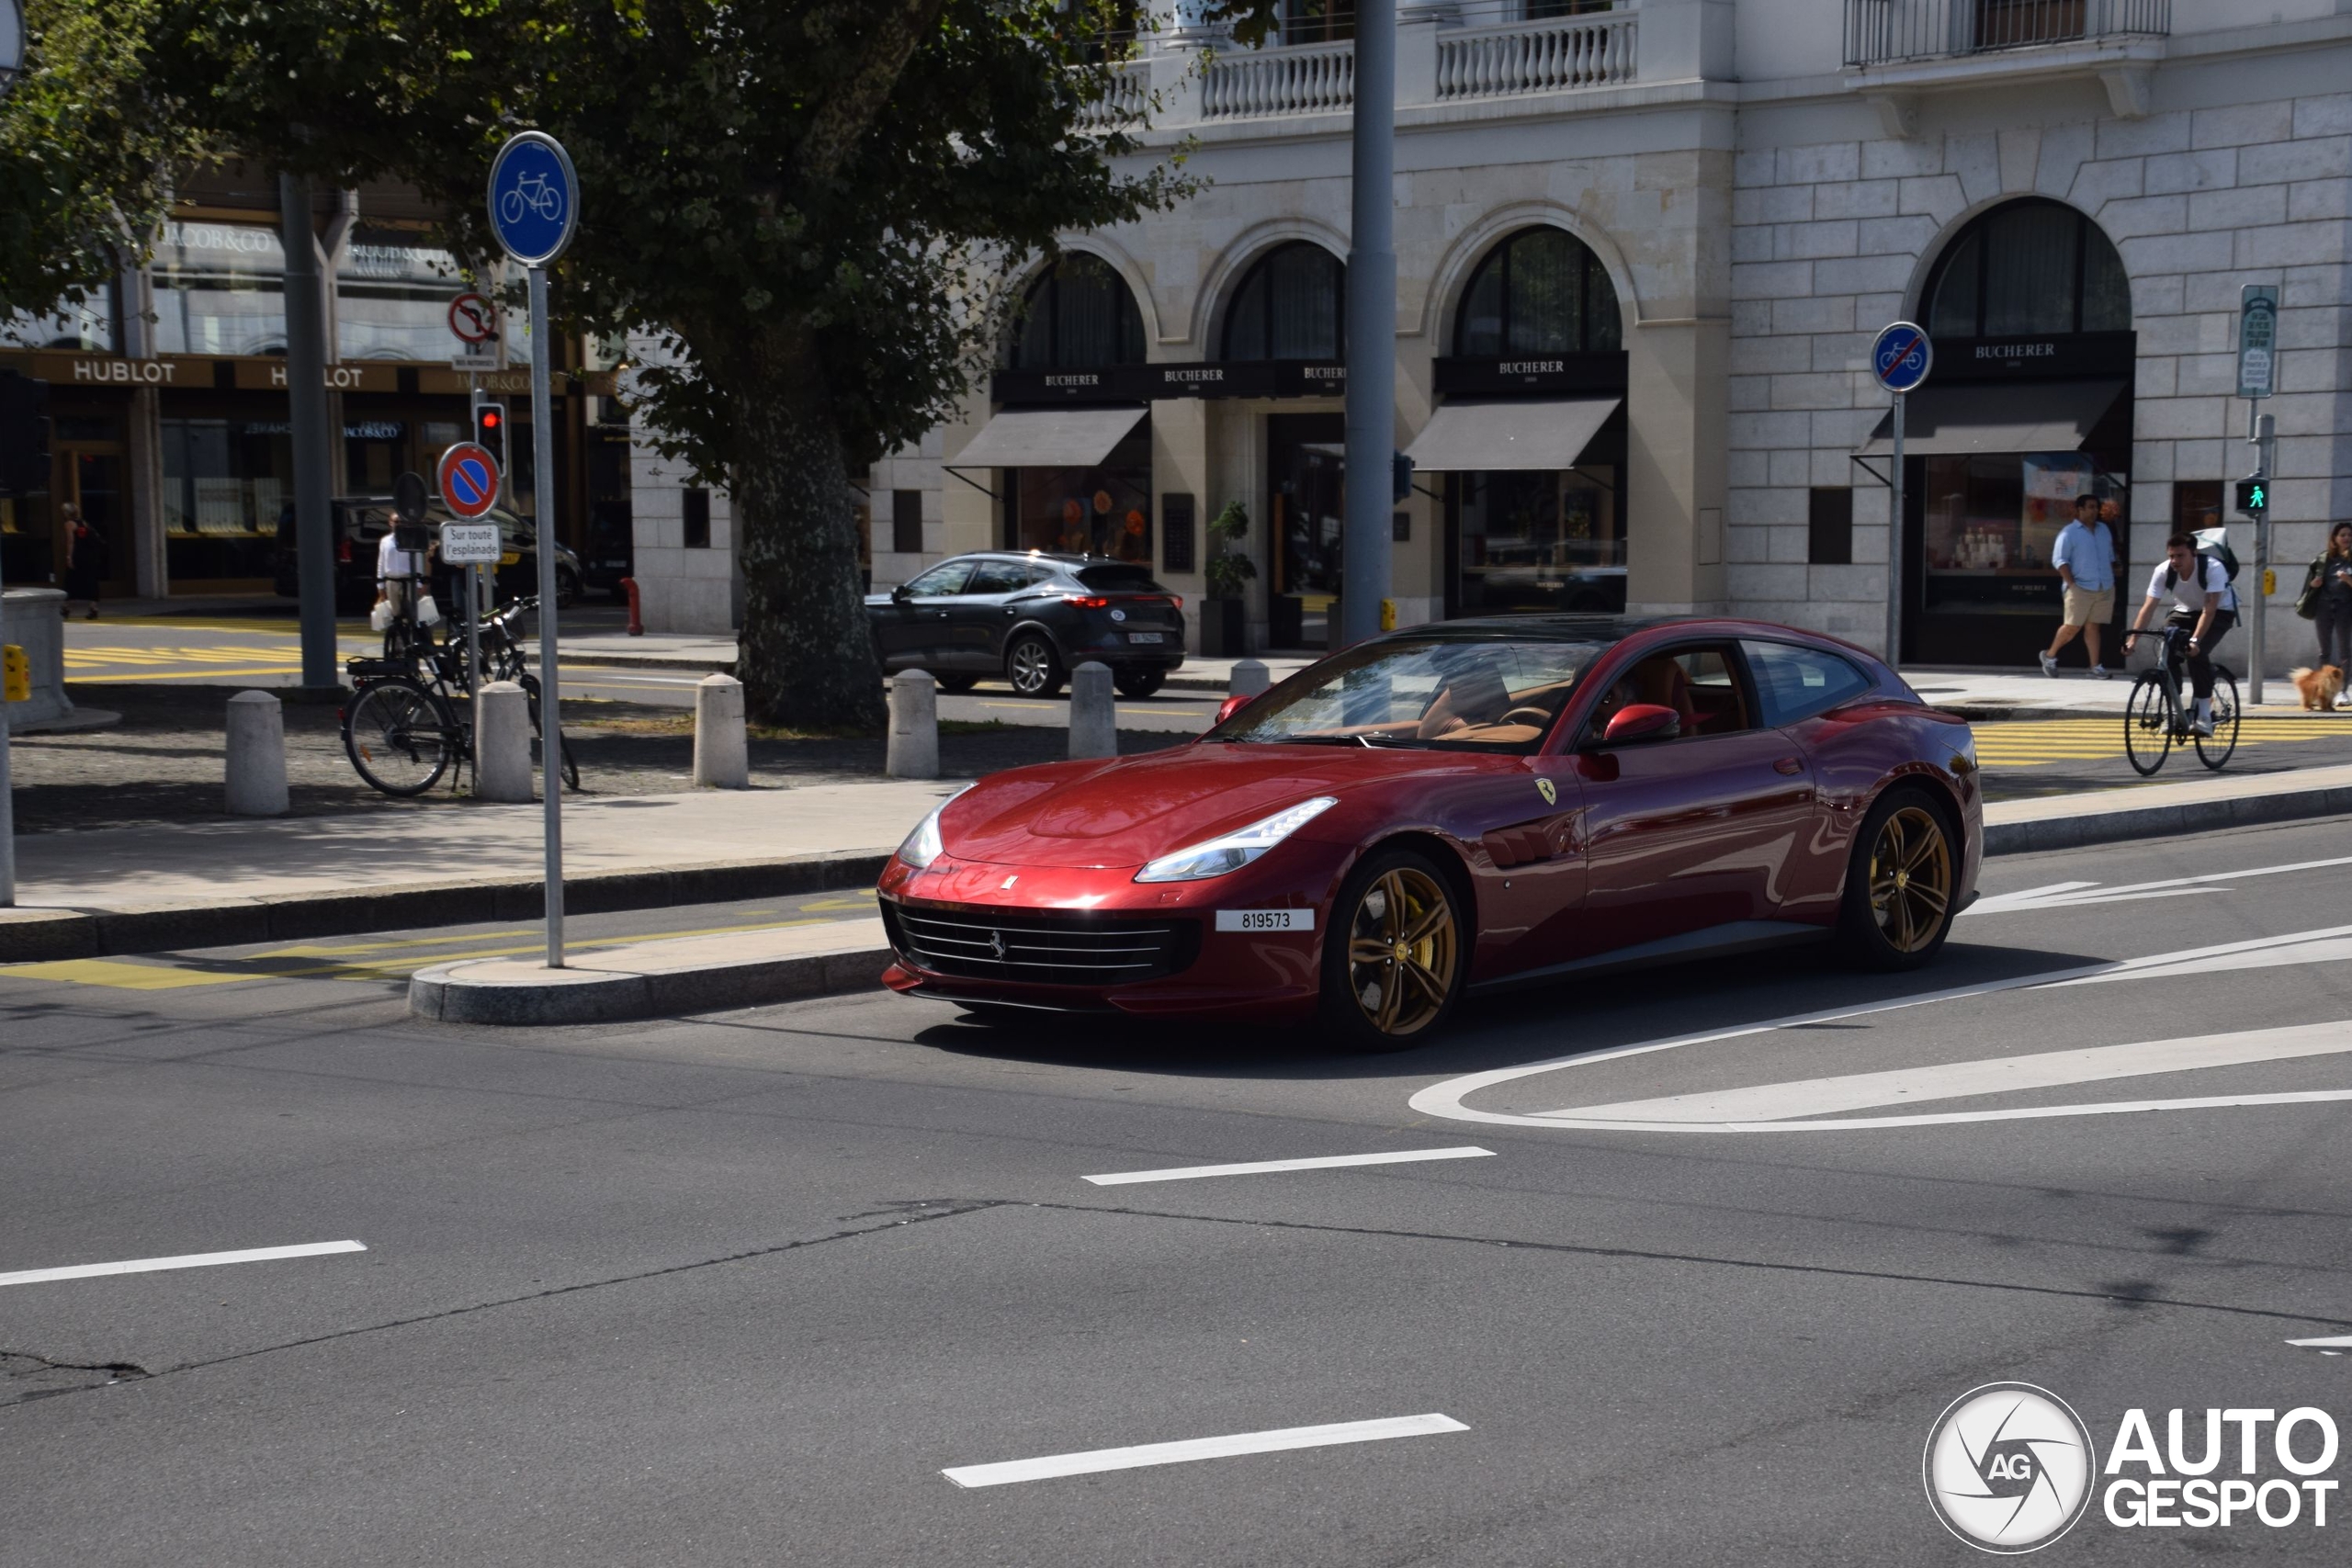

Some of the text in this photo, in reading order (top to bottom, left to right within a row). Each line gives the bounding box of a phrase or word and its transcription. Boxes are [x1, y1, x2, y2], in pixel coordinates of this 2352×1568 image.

[1975, 343, 2054, 358] BUCHERER
[73, 360, 176, 383] HUBLOT
[1304, 367, 1347, 379] BUCHER
[1499, 360, 1564, 374] BUCHERER
[271, 366, 363, 388] HLOT
[1045, 374, 1100, 387] BUCHERER
[1164, 369, 1224, 382] BUCHERER
[450, 530, 492, 540] Sur toute
[446, 544, 497, 557] l'esplanade
[1242, 912, 1290, 928] 819573
